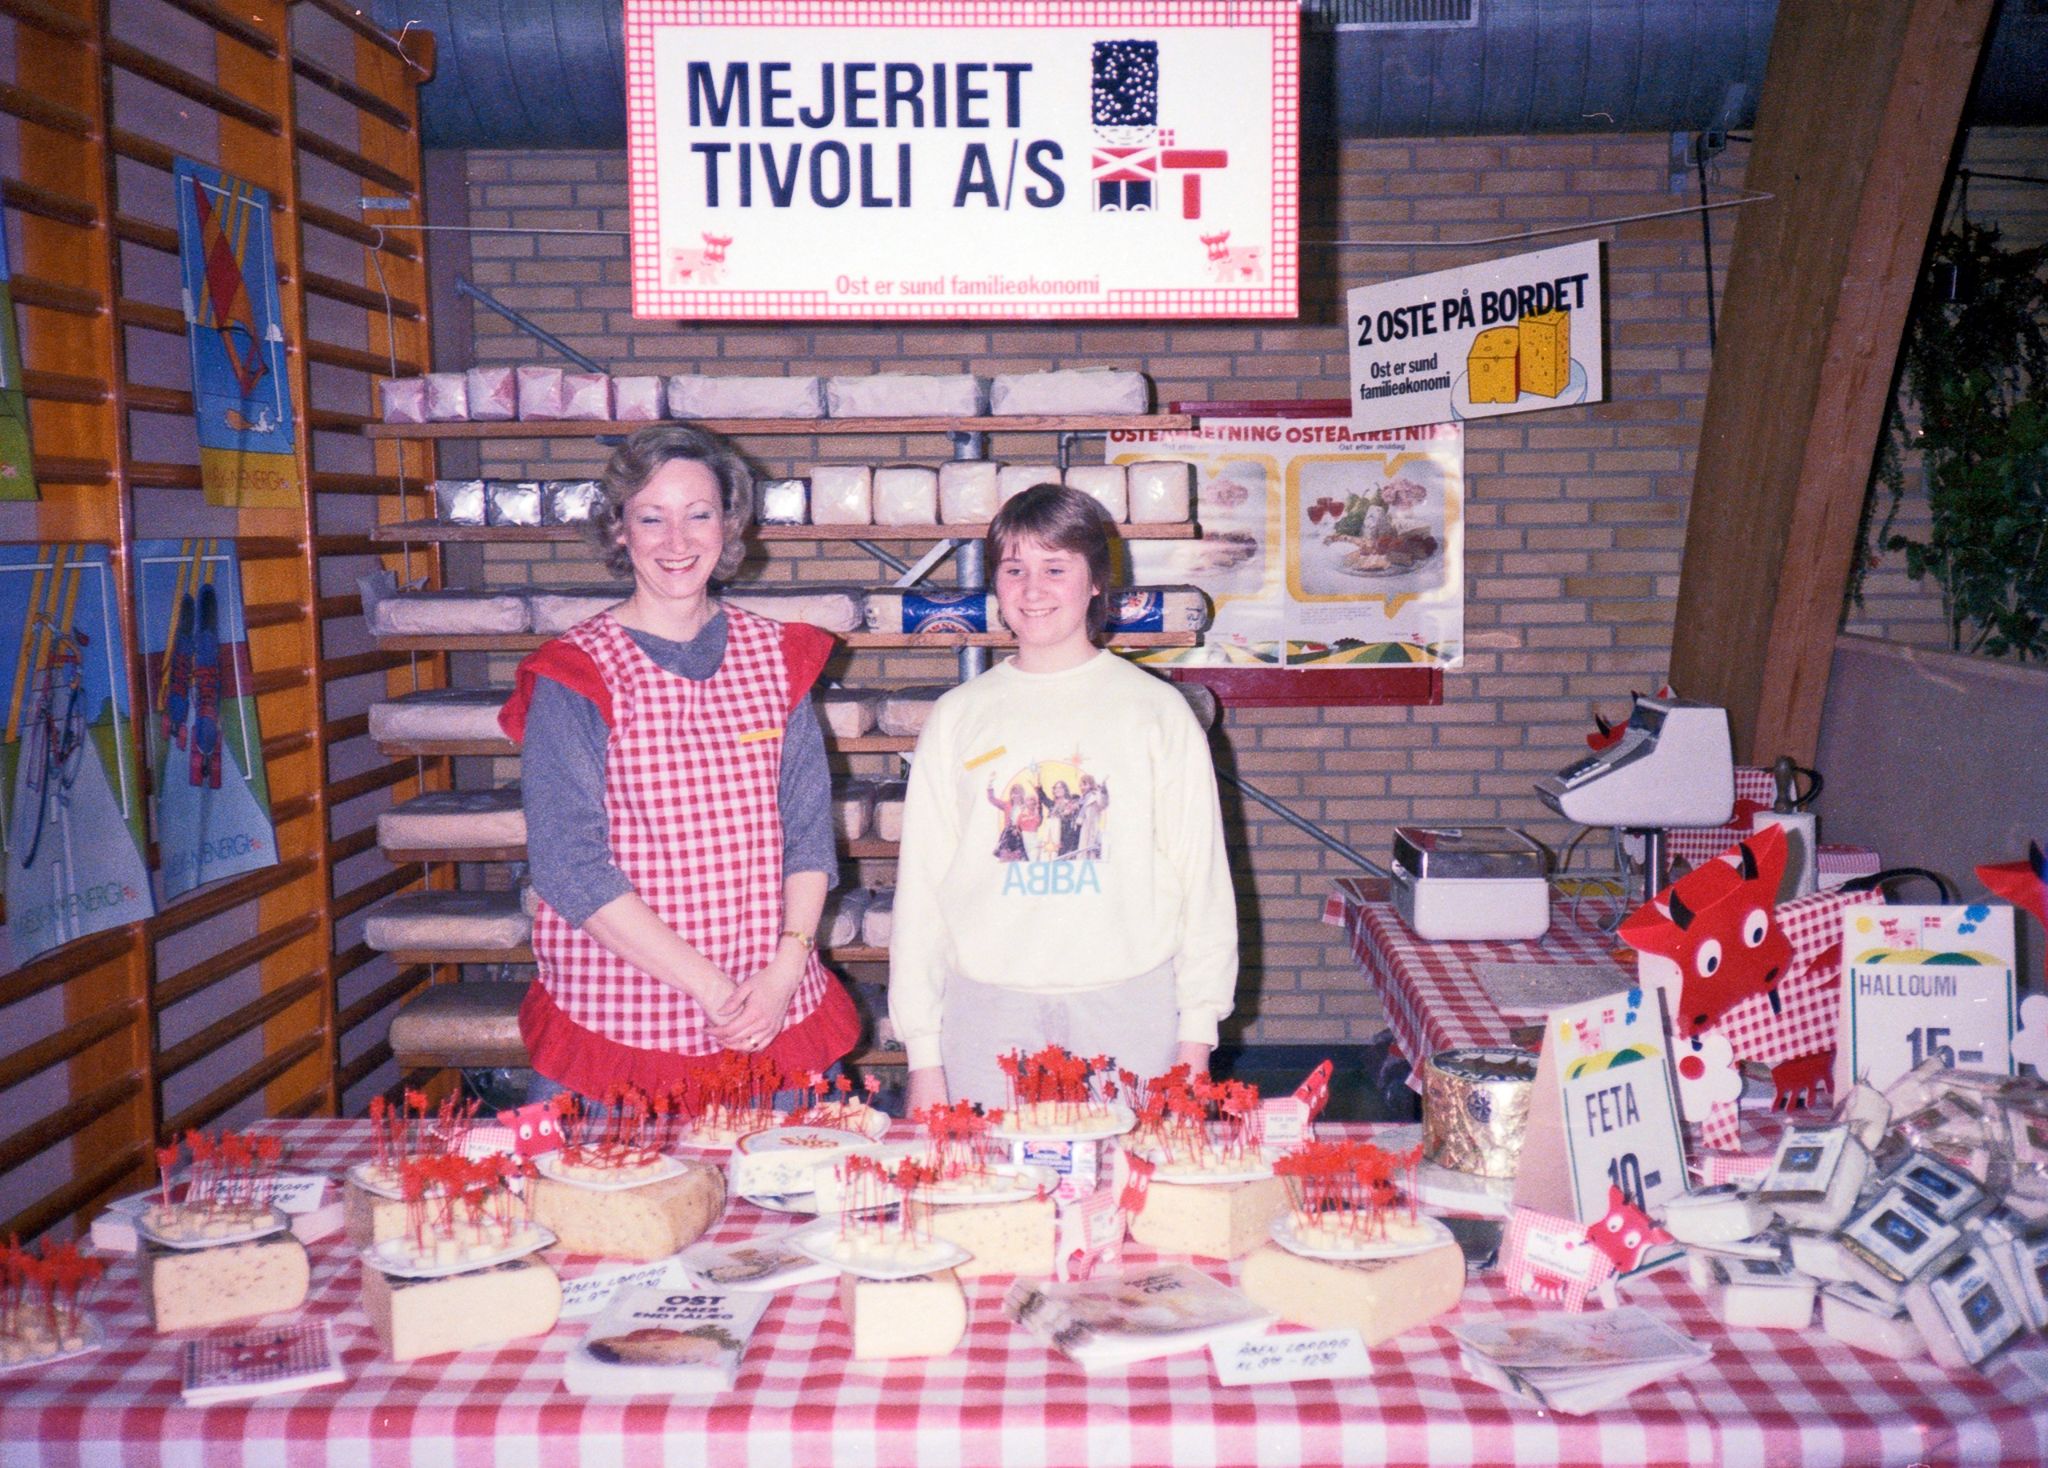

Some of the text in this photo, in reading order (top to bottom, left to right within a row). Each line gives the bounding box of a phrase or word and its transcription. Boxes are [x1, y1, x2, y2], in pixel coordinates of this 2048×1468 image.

[687, 61, 1033, 129] MEJERIET
[691, 138, 1066, 211] TIVOLI A/S
[835, 274, 1100, 295] Ost er sund familieøkonomi
[1357, 273, 1589, 346] 2 OSTE PÅ BORDET
[1370, 352, 1438, 379] Ost er sund
[1360, 371, 1451, 400] familieøkonomi
[1110, 426, 1282, 442] OSTEETNING
[1285, 424, 1459, 443] OSTEANRETNI
[1001, 859, 1102, 897] ABBA
[1860, 974, 1957, 997] HALLOUMI
[1585, 1082, 1640, 1137] FETA
[664, 1295, 726, 1306] OST
[631, 1311, 669, 1319] END
